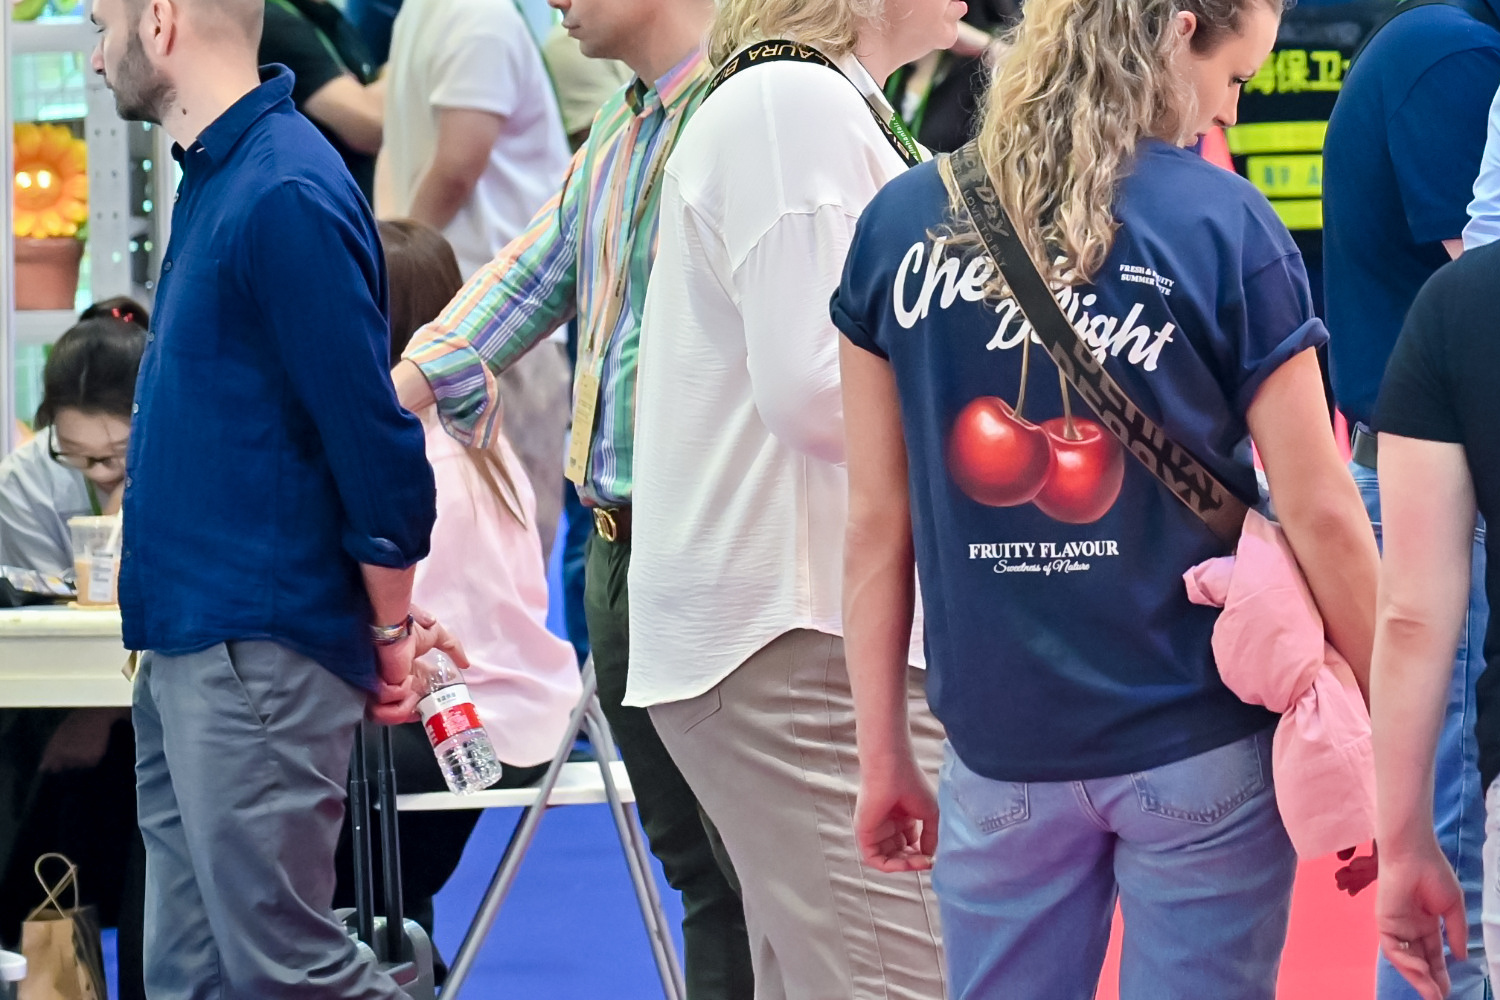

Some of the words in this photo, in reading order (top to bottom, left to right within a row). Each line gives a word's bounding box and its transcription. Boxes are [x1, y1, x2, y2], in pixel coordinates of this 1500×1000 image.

[749, 43, 830, 68] LAURA
[963, 189, 982, 222] LOVE
[981, 221, 993, 242] TO
[1119, 263, 1145, 275] FRESH
[1120, 273, 1155, 286] SUMMER
[968, 542, 1036, 559] FRUITY
[1039, 540, 1119, 558] FLAVOUR
[993, 559, 1041, 573] Sweetness
[1042, 562, 1052, 576] of
[1052, 559, 1090, 573] Nature
